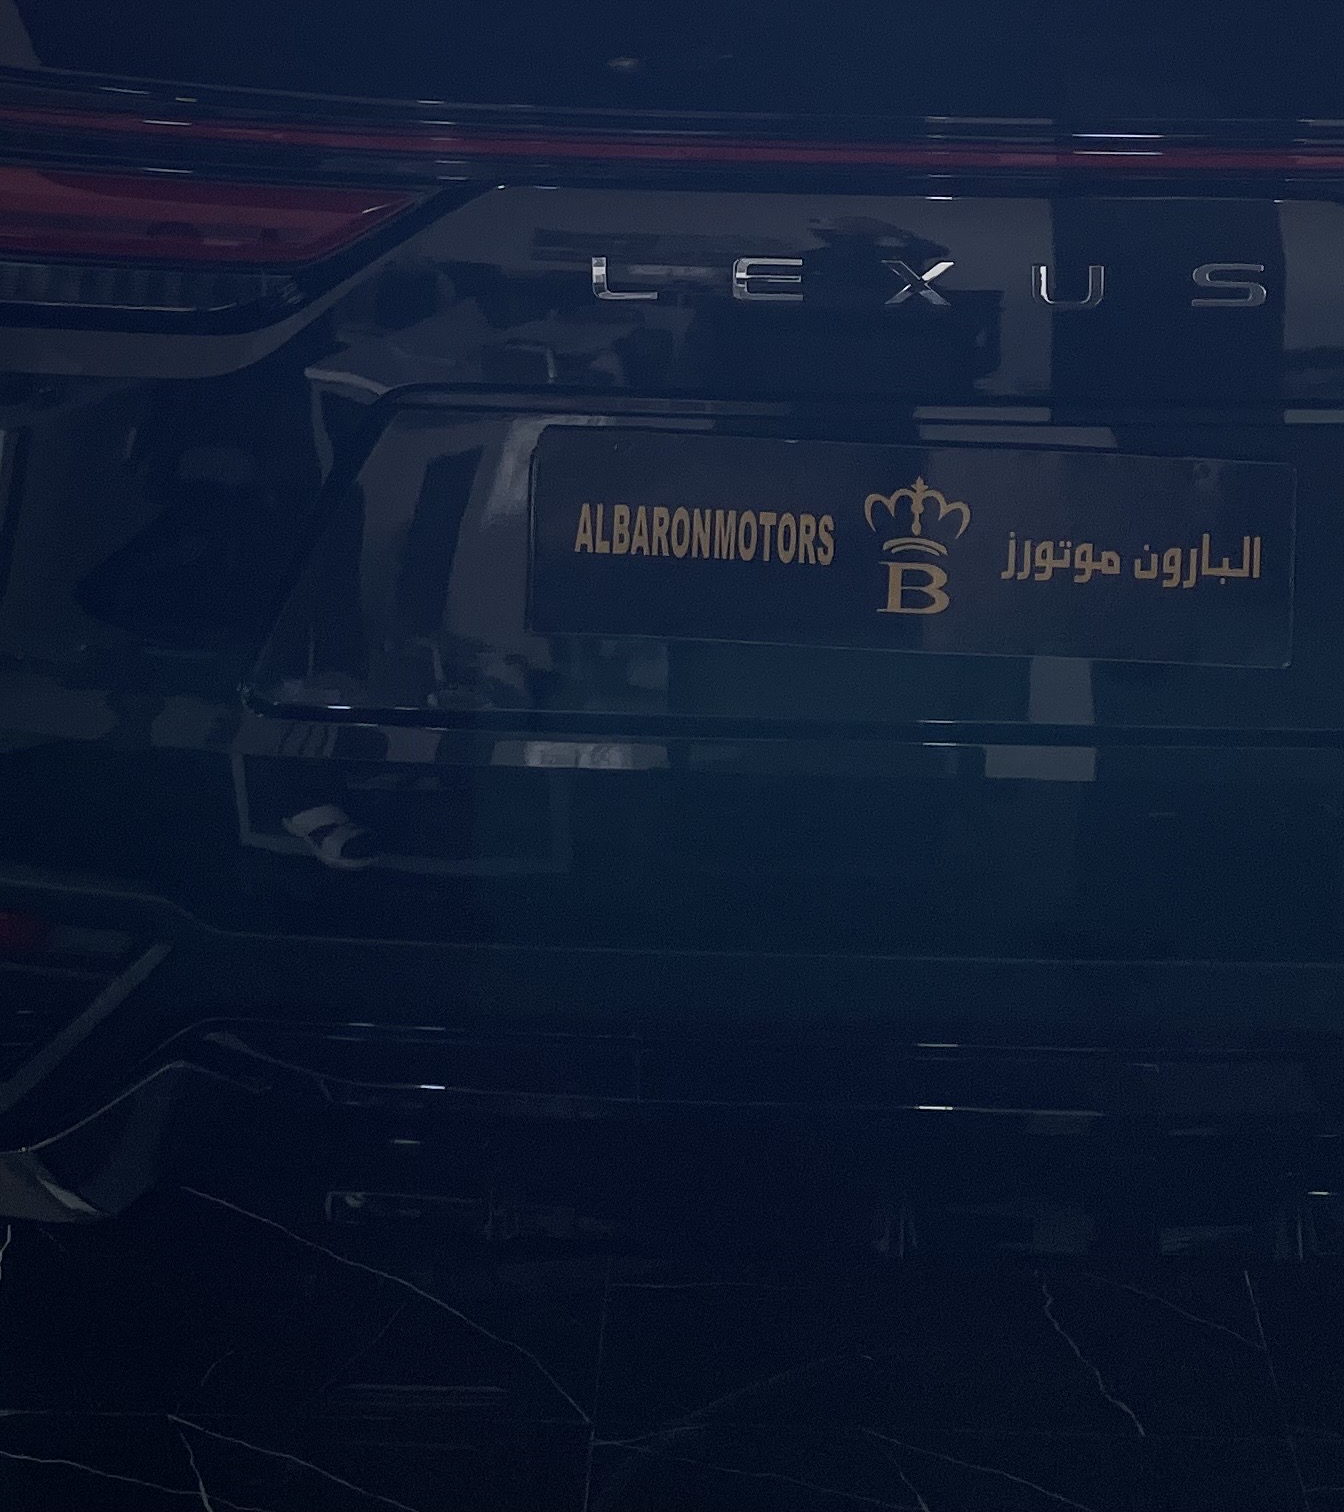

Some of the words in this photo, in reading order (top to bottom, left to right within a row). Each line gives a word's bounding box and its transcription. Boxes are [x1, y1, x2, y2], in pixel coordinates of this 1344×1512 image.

[591, 256, 1268, 308] LEXUS
[573, 502, 835, 566] ALBARONMOTORS
[1000, 531, 1121, 584] موتورز
[1133, 533, 1262, 589] البارون
[876, 561, 951, 615] B
